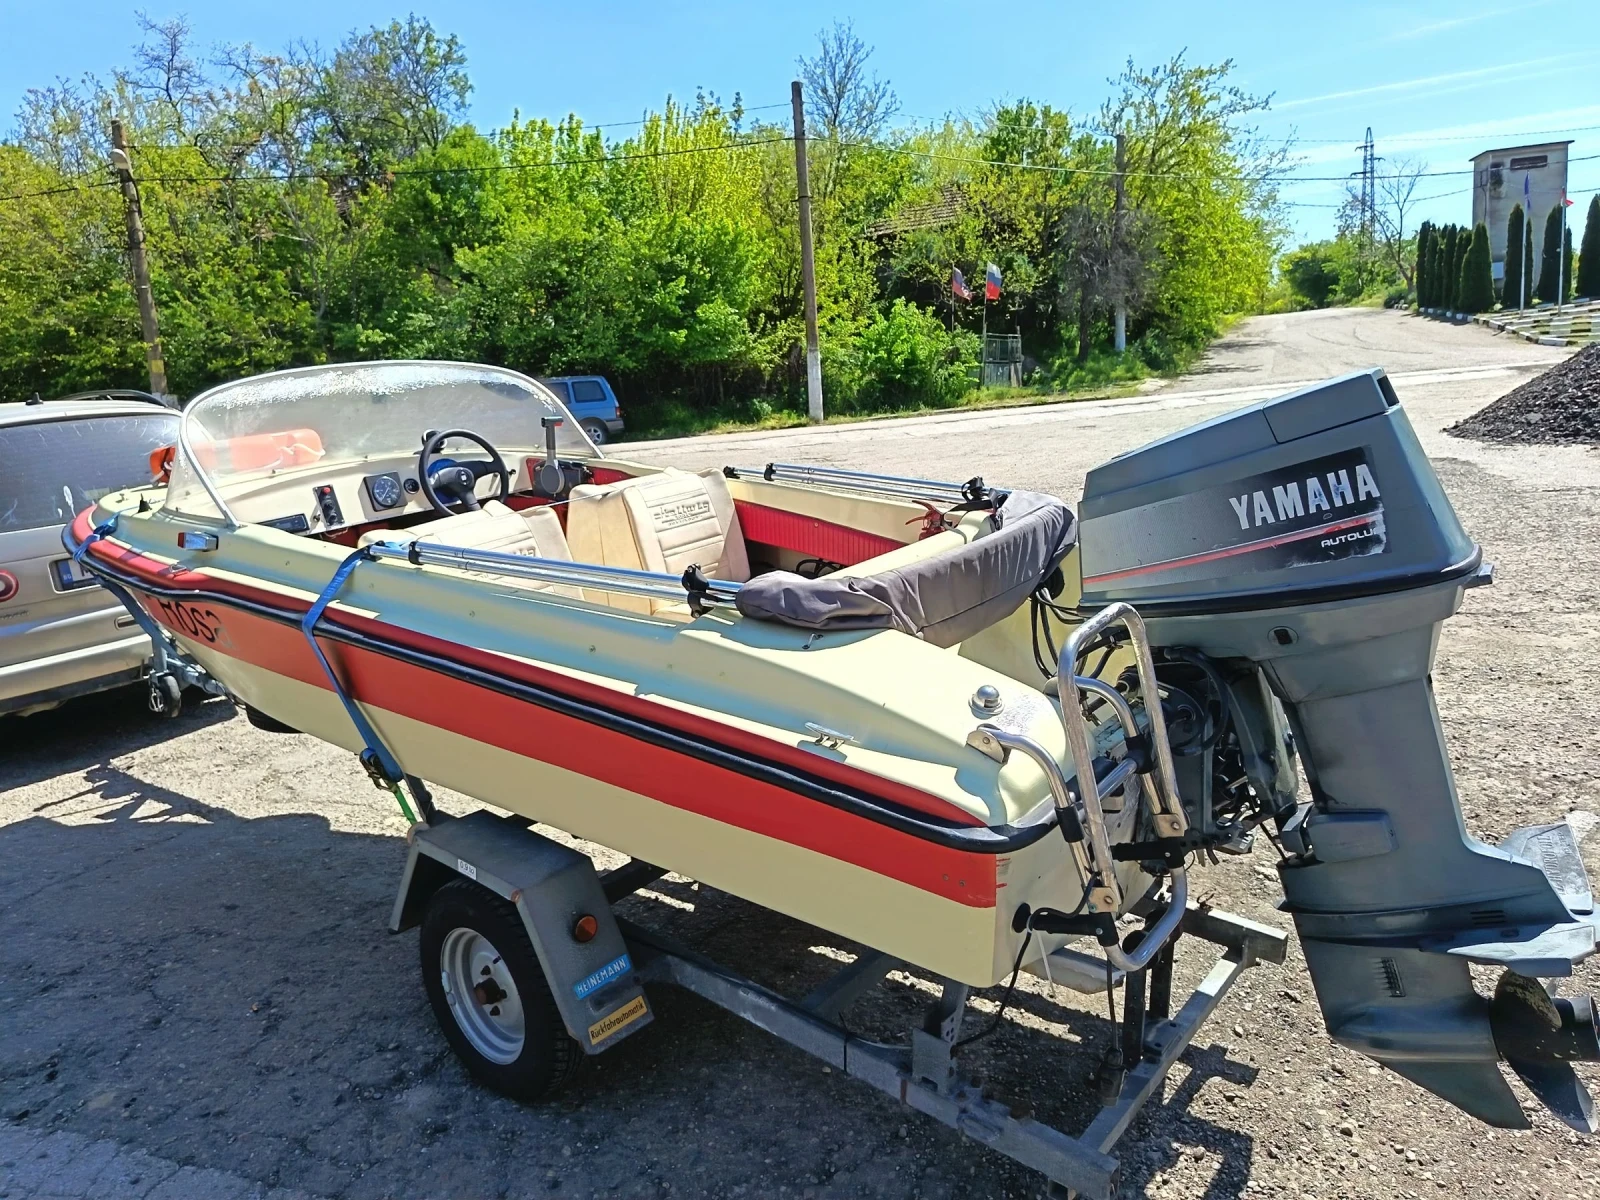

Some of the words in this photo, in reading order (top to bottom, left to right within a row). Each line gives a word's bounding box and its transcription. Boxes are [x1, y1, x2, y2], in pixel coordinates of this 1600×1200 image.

[1228, 463, 1381, 530] YAMAHA
[577, 958, 627, 994] HEINEMANN
[590, 1000, 645, 1040] Rückfahrautomatik
